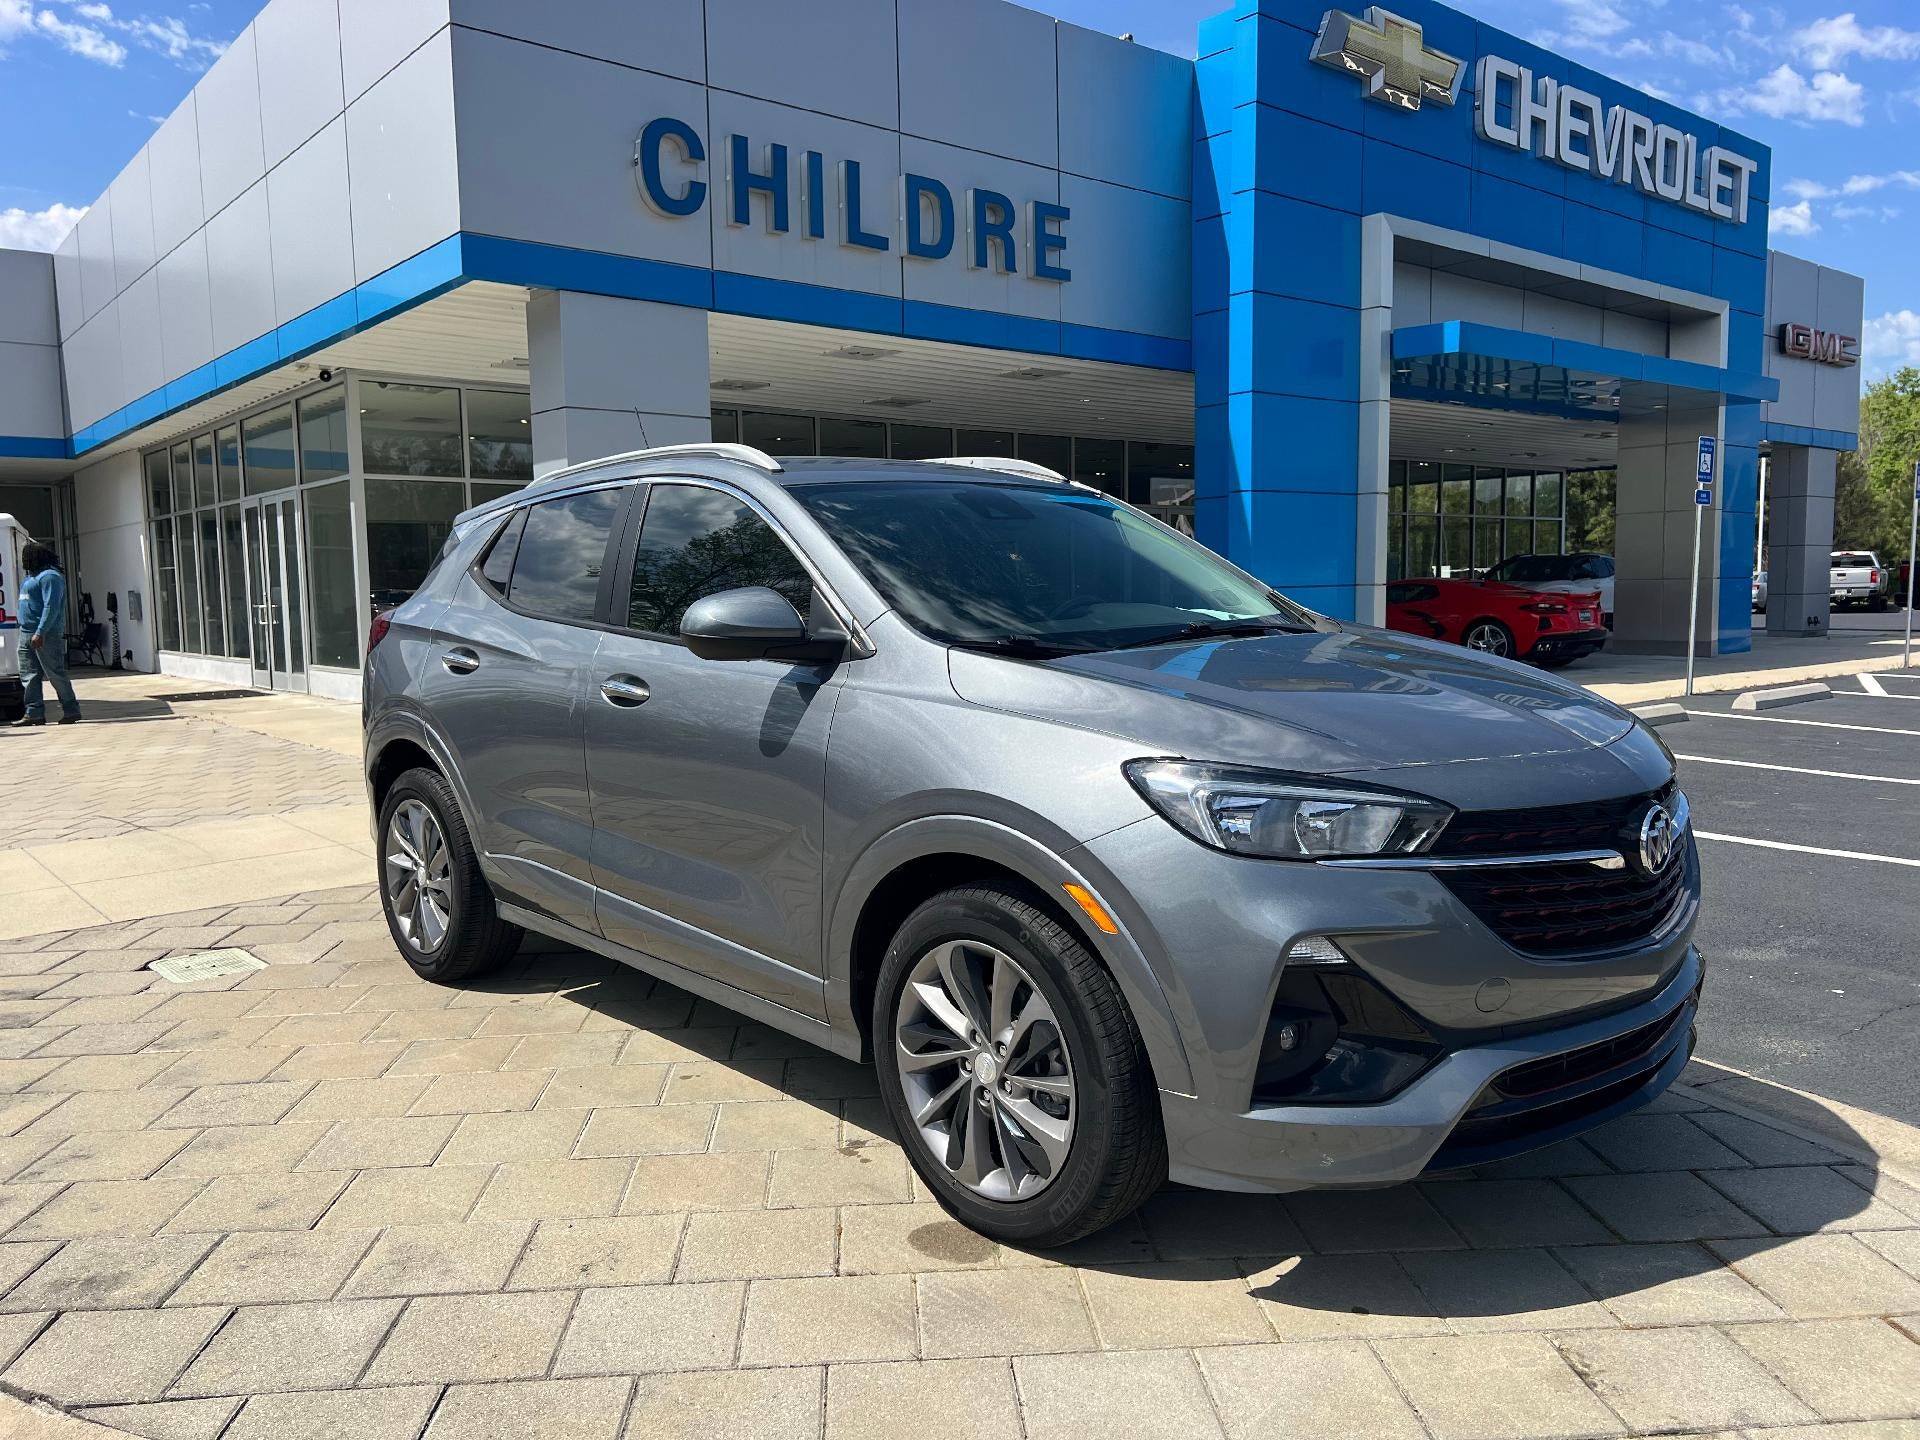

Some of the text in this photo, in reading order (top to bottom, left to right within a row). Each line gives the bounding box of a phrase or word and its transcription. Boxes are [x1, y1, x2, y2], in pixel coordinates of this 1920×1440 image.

[634, 117, 1072, 283] CHILDRE
[1475, 54, 1757, 224] CHEVROLET
[1782, 322, 1858, 367] GMC
